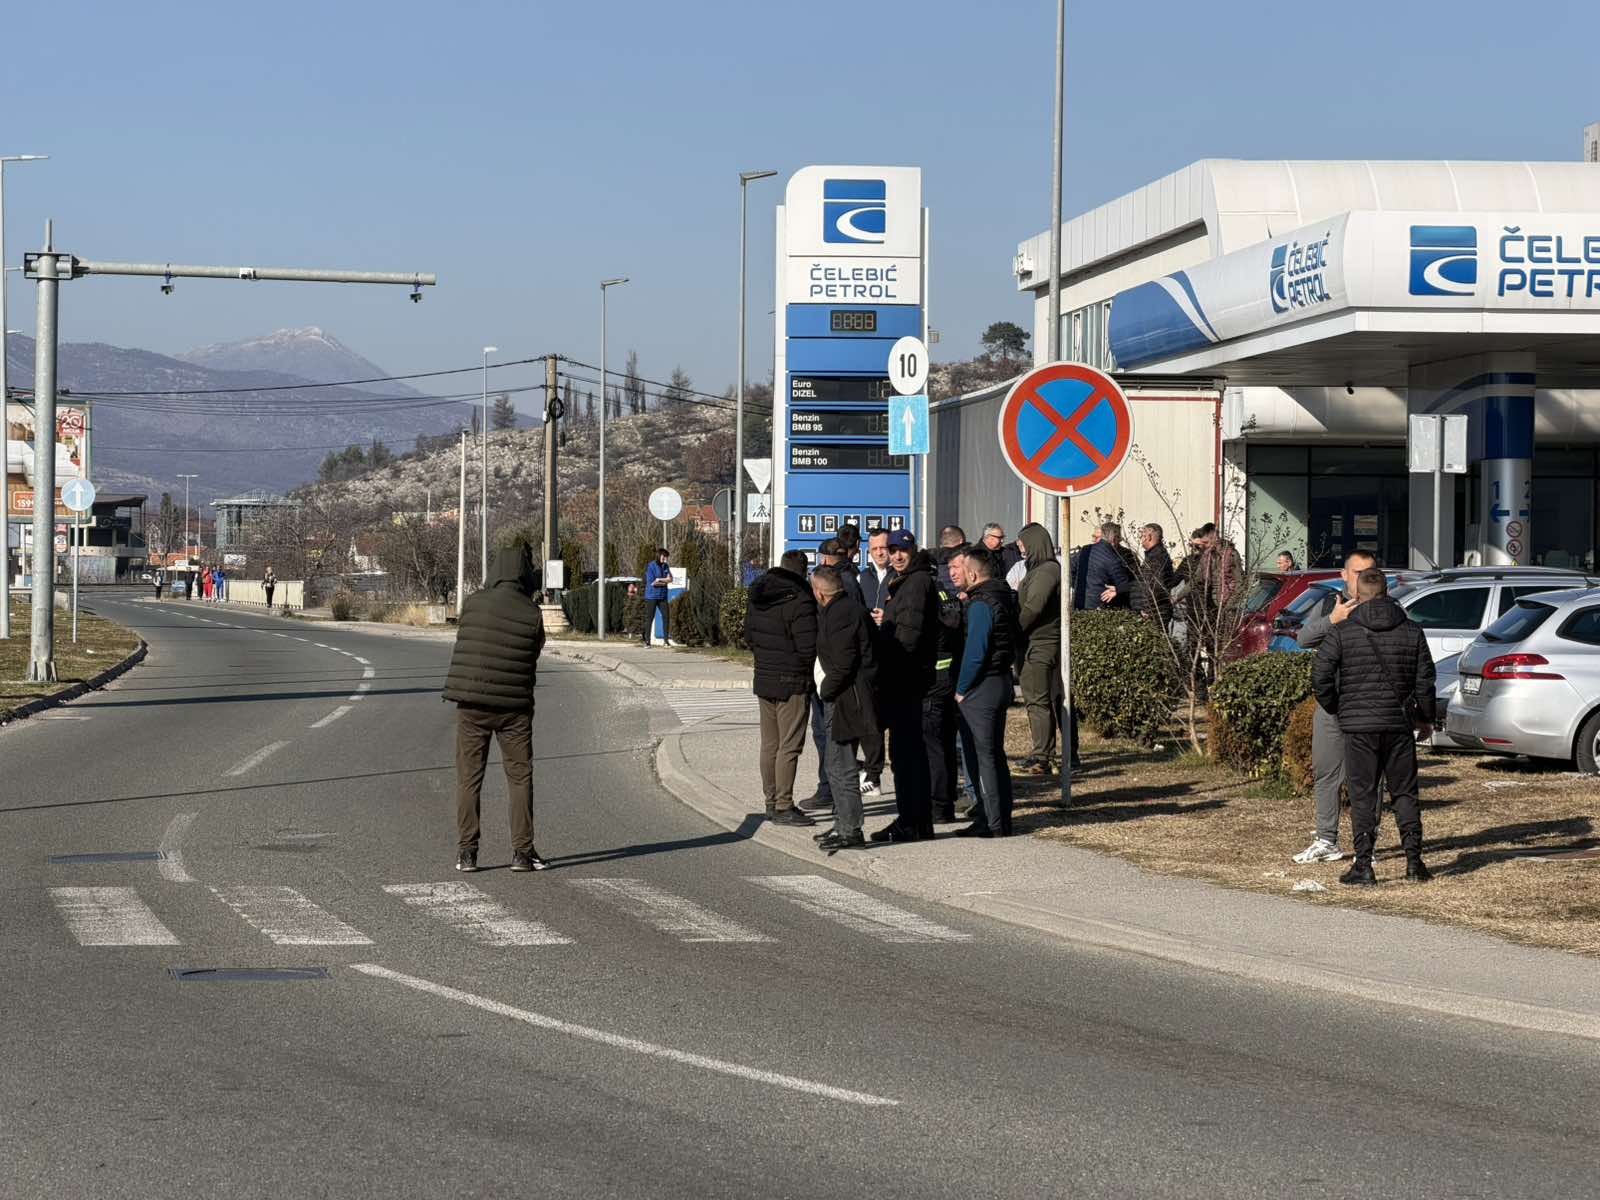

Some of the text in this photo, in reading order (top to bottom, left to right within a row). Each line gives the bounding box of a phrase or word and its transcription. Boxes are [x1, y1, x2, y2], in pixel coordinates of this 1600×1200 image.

[1499, 225, 1600, 264] ČELE
[1288, 230, 1331, 277] ČELEBIĆ
[810, 263, 897, 281] ČELEBIĆ
[809, 284, 897, 298] PETROL
[1288, 271, 1332, 309] PETROL
[899, 353, 917, 378] 10
[792, 380, 812, 388] Euro
[792, 389, 817, 398] DIZEL
[792, 413, 820, 422] Benzin
[792, 423, 823, 431] BMB 95
[792, 447, 820, 456] Benzin
[792, 457, 828, 466] BMB 100
[1491, 480, 1500, 499] 1
